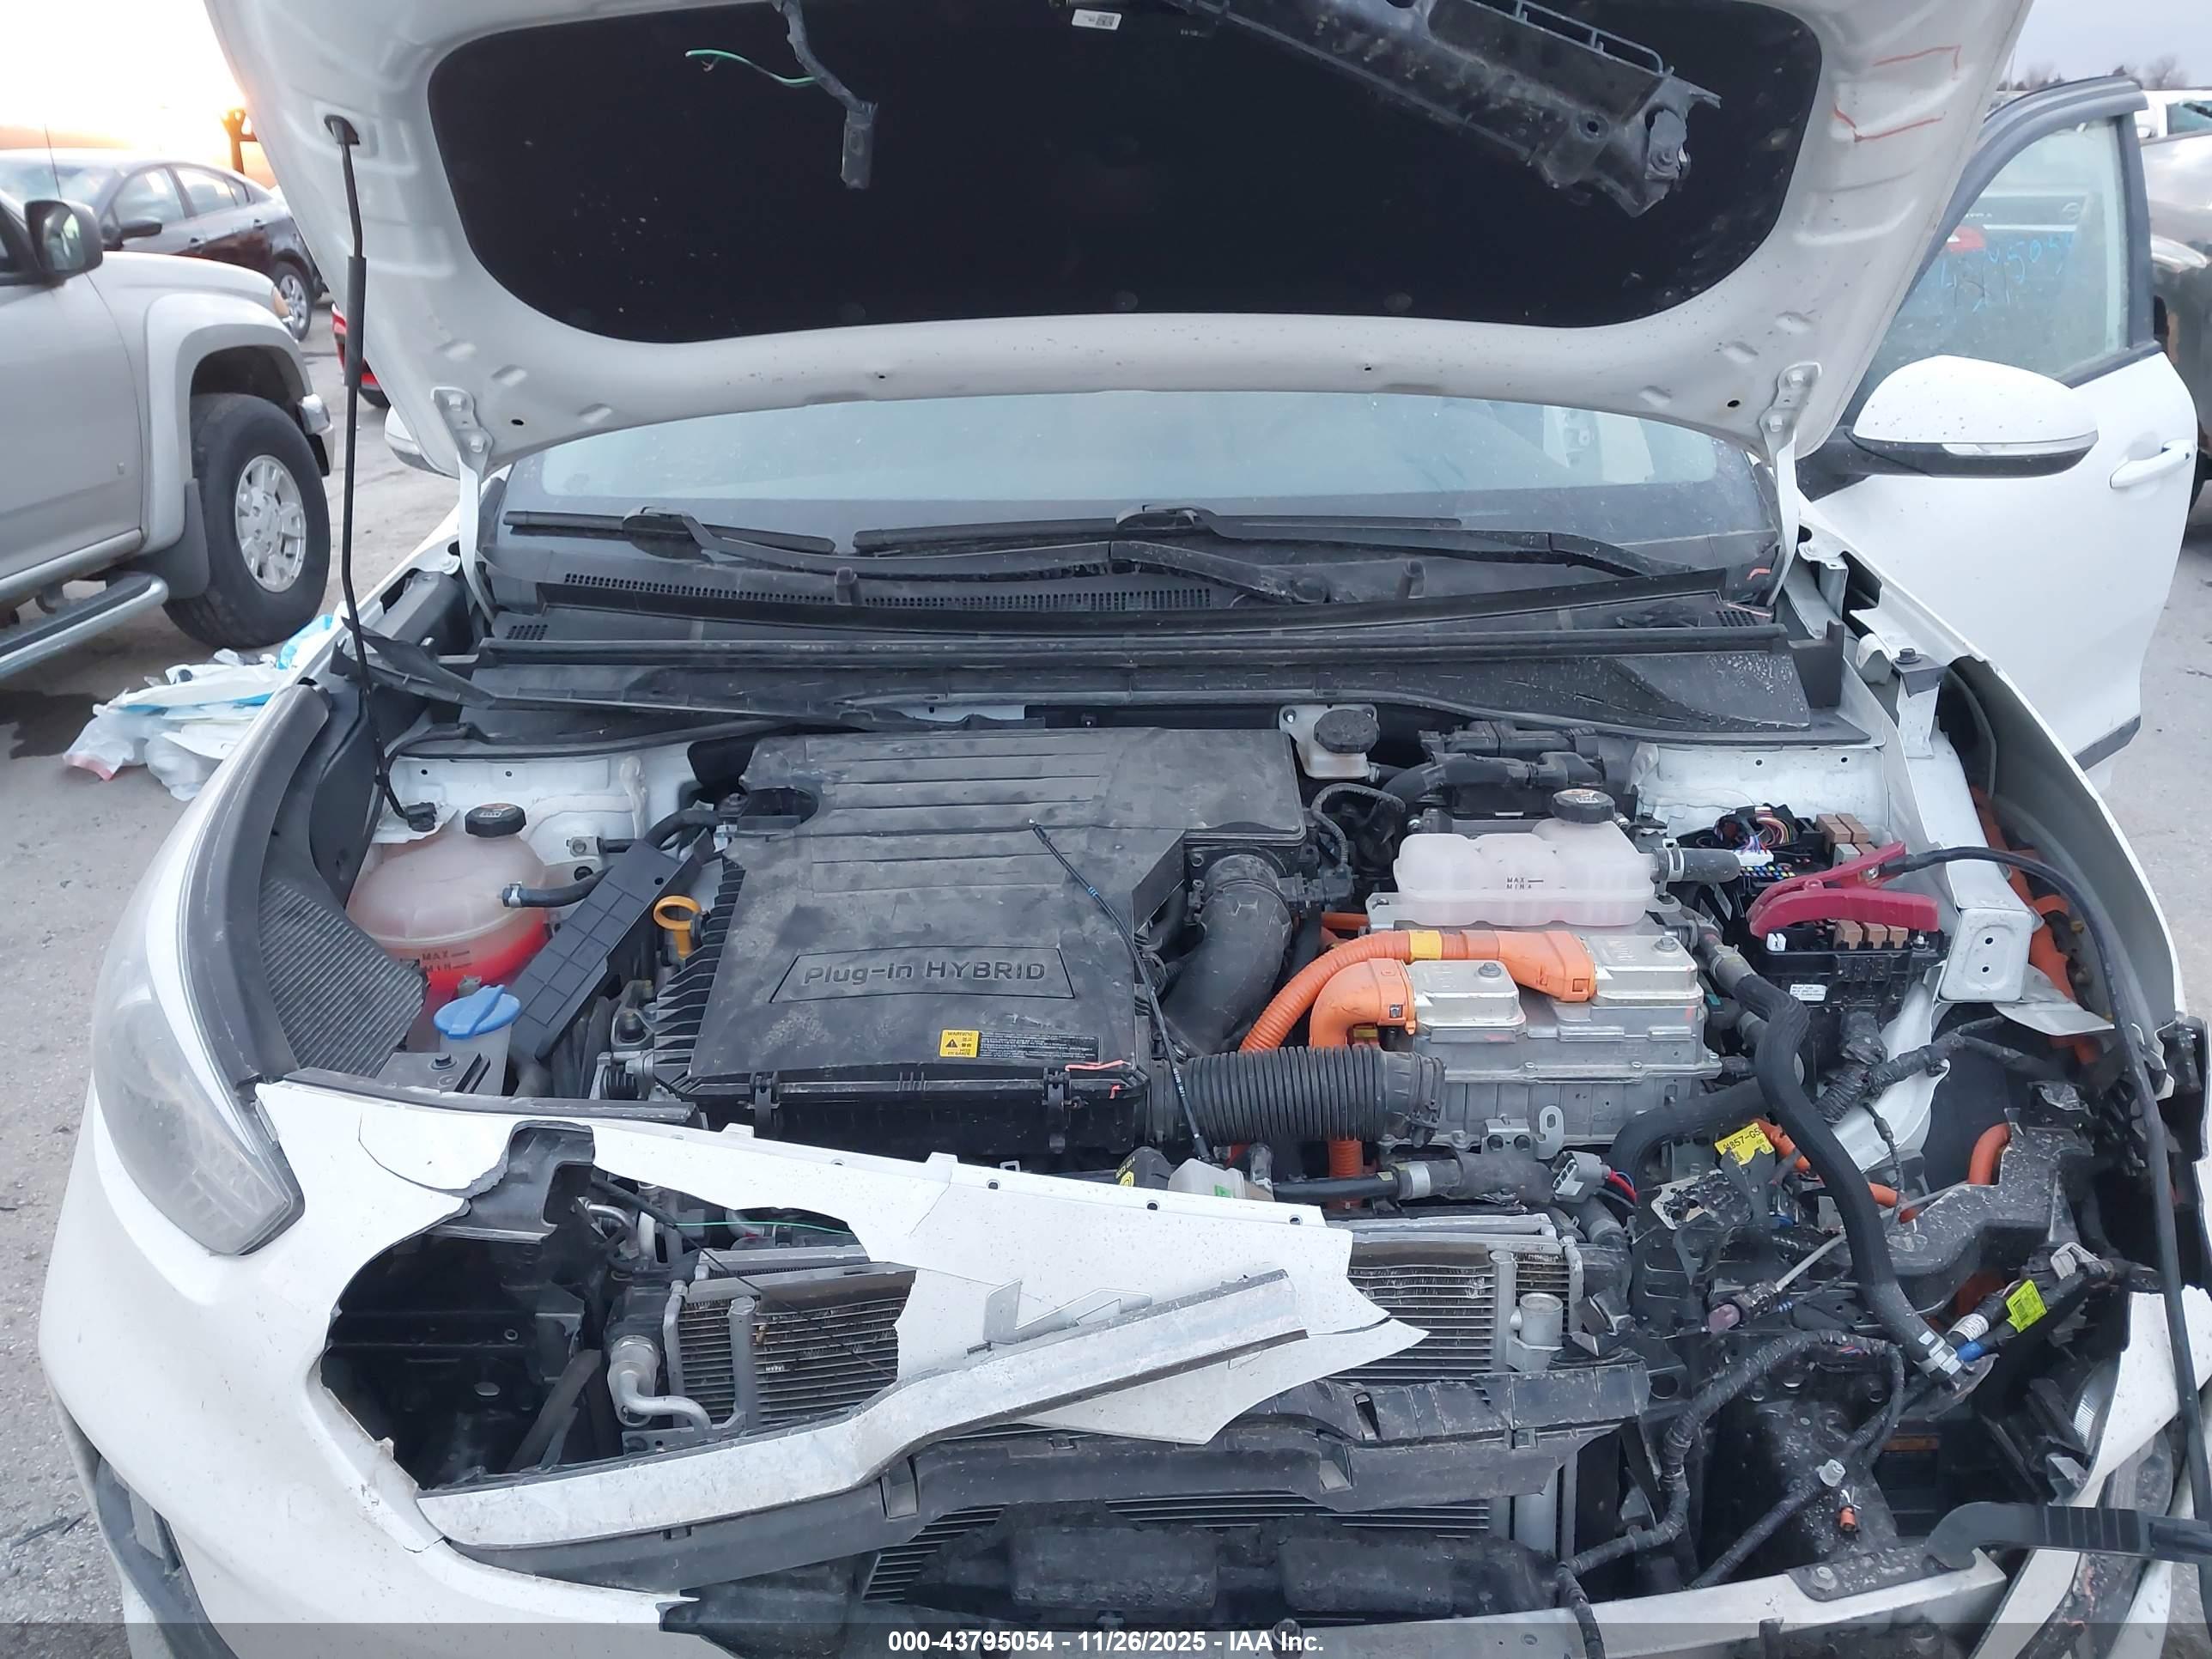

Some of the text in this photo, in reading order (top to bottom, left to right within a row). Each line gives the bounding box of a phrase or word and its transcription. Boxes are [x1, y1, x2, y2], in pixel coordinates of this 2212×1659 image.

[422, 949, 448, 961] MAX
[804, 960, 1046, 986] Plug-in HYBRID
